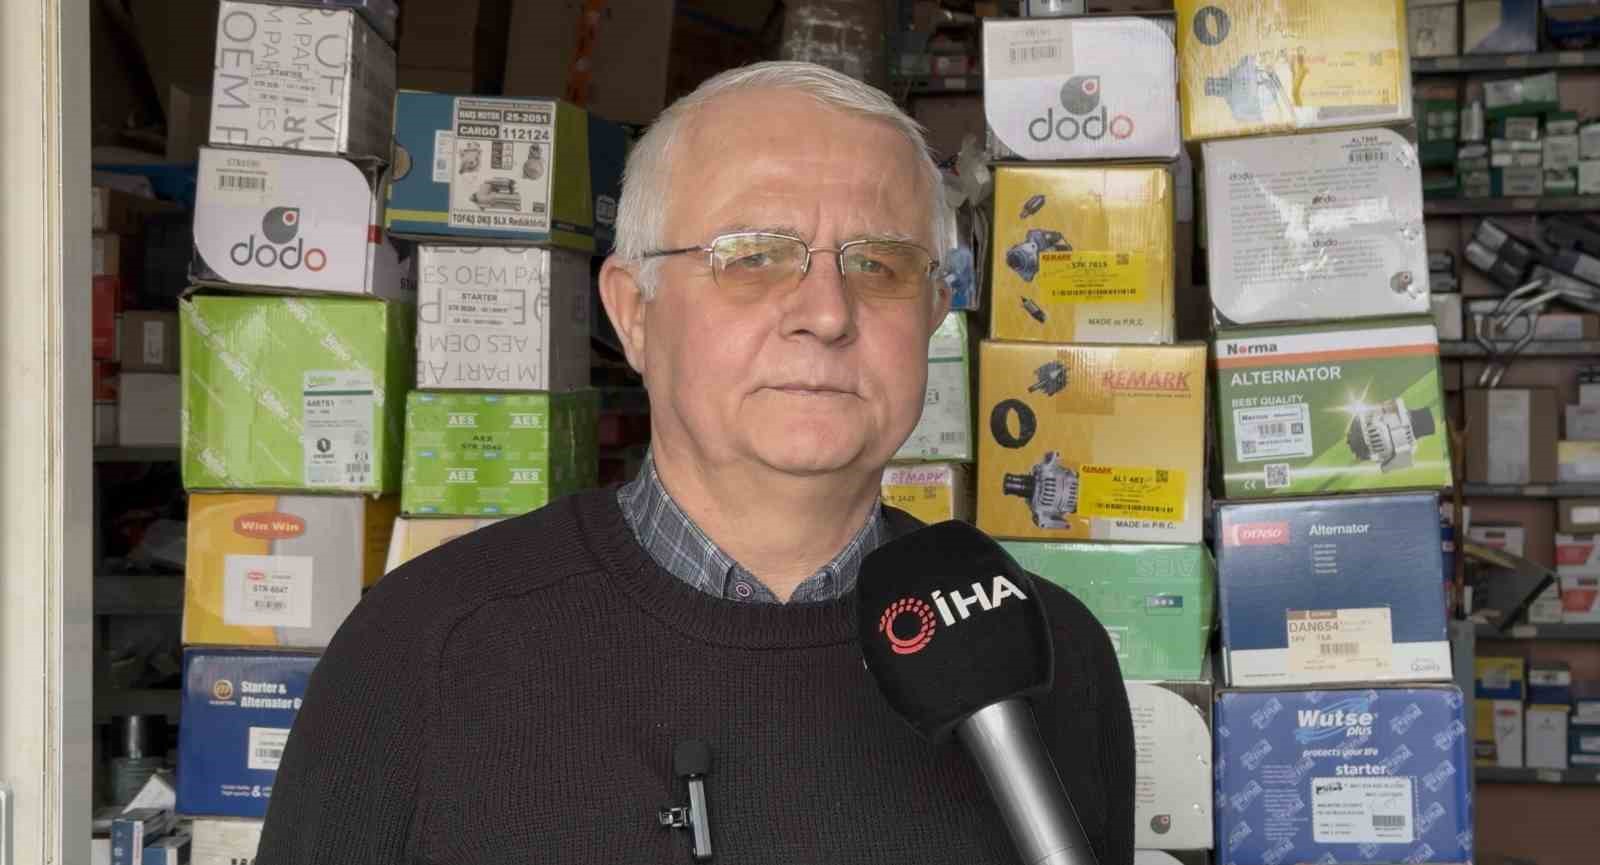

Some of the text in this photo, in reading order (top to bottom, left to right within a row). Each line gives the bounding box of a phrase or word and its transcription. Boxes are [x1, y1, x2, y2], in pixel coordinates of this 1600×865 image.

[217, 11, 257, 109] OEM
[1028, 105, 1135, 142] dodo
[459, 125, 498, 138] CARGO
[502, 127, 550, 141] 112124
[229, 233, 327, 272] dodo
[455, 264, 507, 287] OEM
[429, 334, 529, 353] AES OEM
[1226, 341, 1278, 356] Norma
[454, 361, 510, 383] PART
[1230, 365, 1342, 387] ALTERNATOR
[1102, 369, 1192, 391] REMARK
[1231, 394, 1304, 408] BEST QUALITY
[448, 414, 476, 426] AES
[512, 415, 540, 427] AES
[448, 470, 476, 481] AES
[512, 471, 540, 482] AES
[890, 471, 946, 483] REMARK
[240, 520, 300, 533] Win Win
[1115, 519, 1141, 529] MADE
[1308, 522, 1371, 537] Alternator
[1240, 527, 1282, 540] DENSO
[930, 574, 1029, 627] İHA
[1288, 620, 1341, 634] DAN654
[240, 680, 277, 693] Starter
[240, 696, 292, 709] Alternator
[1297, 709, 1375, 728] Wutse
[1345, 724, 1373, 738] plus
[1302, 747, 1341, 759] protects
[1342, 748, 1364, 759] your
[1334, 763, 1389, 776] starter
